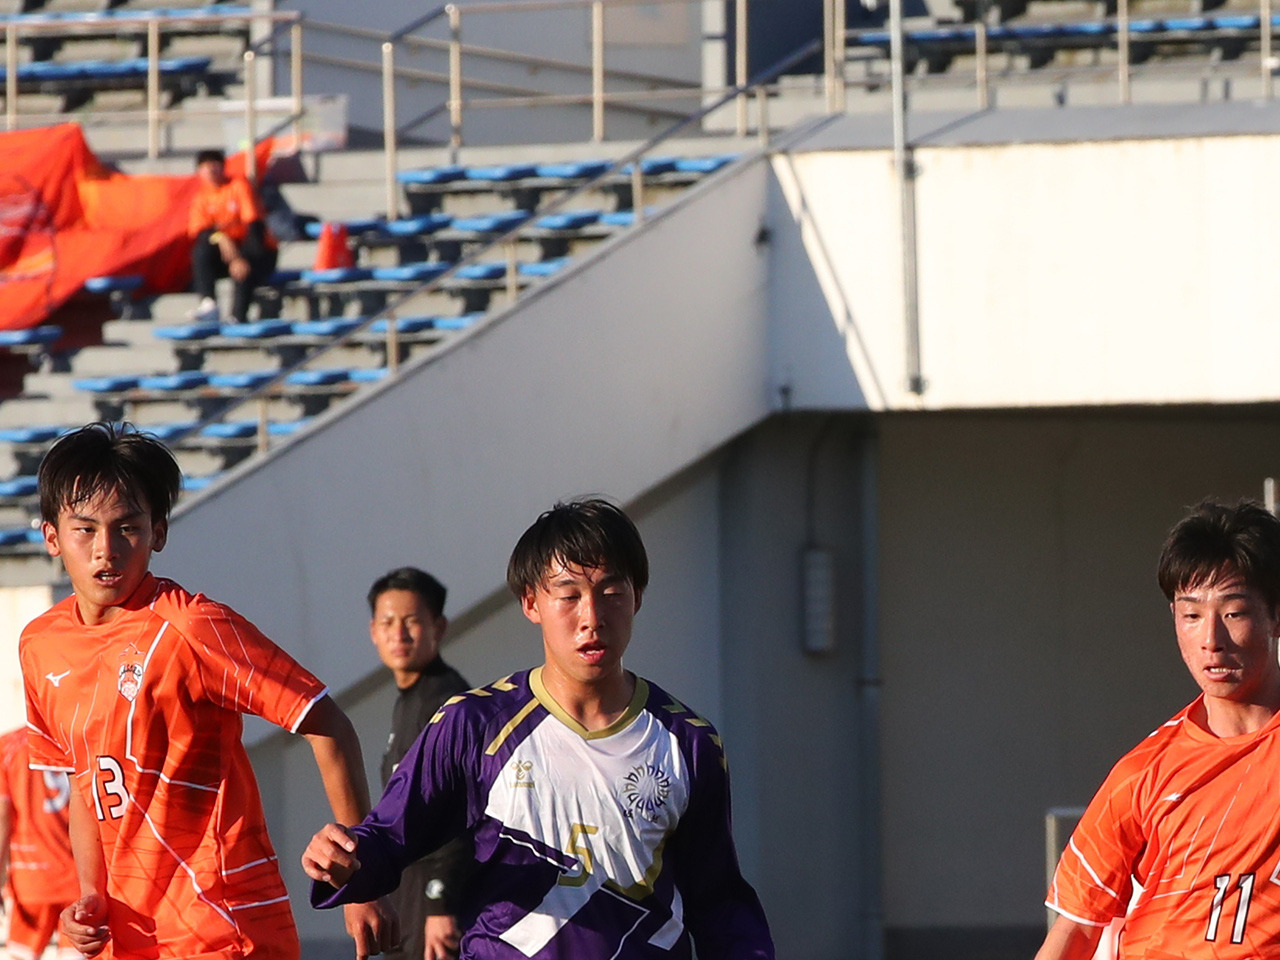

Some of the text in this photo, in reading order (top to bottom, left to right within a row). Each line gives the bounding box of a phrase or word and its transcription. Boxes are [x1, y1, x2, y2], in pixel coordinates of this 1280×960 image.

[92, 755, 130, 821] 13
[557, 823, 599, 887] 5
[1205, 873, 1255, 944] 11
